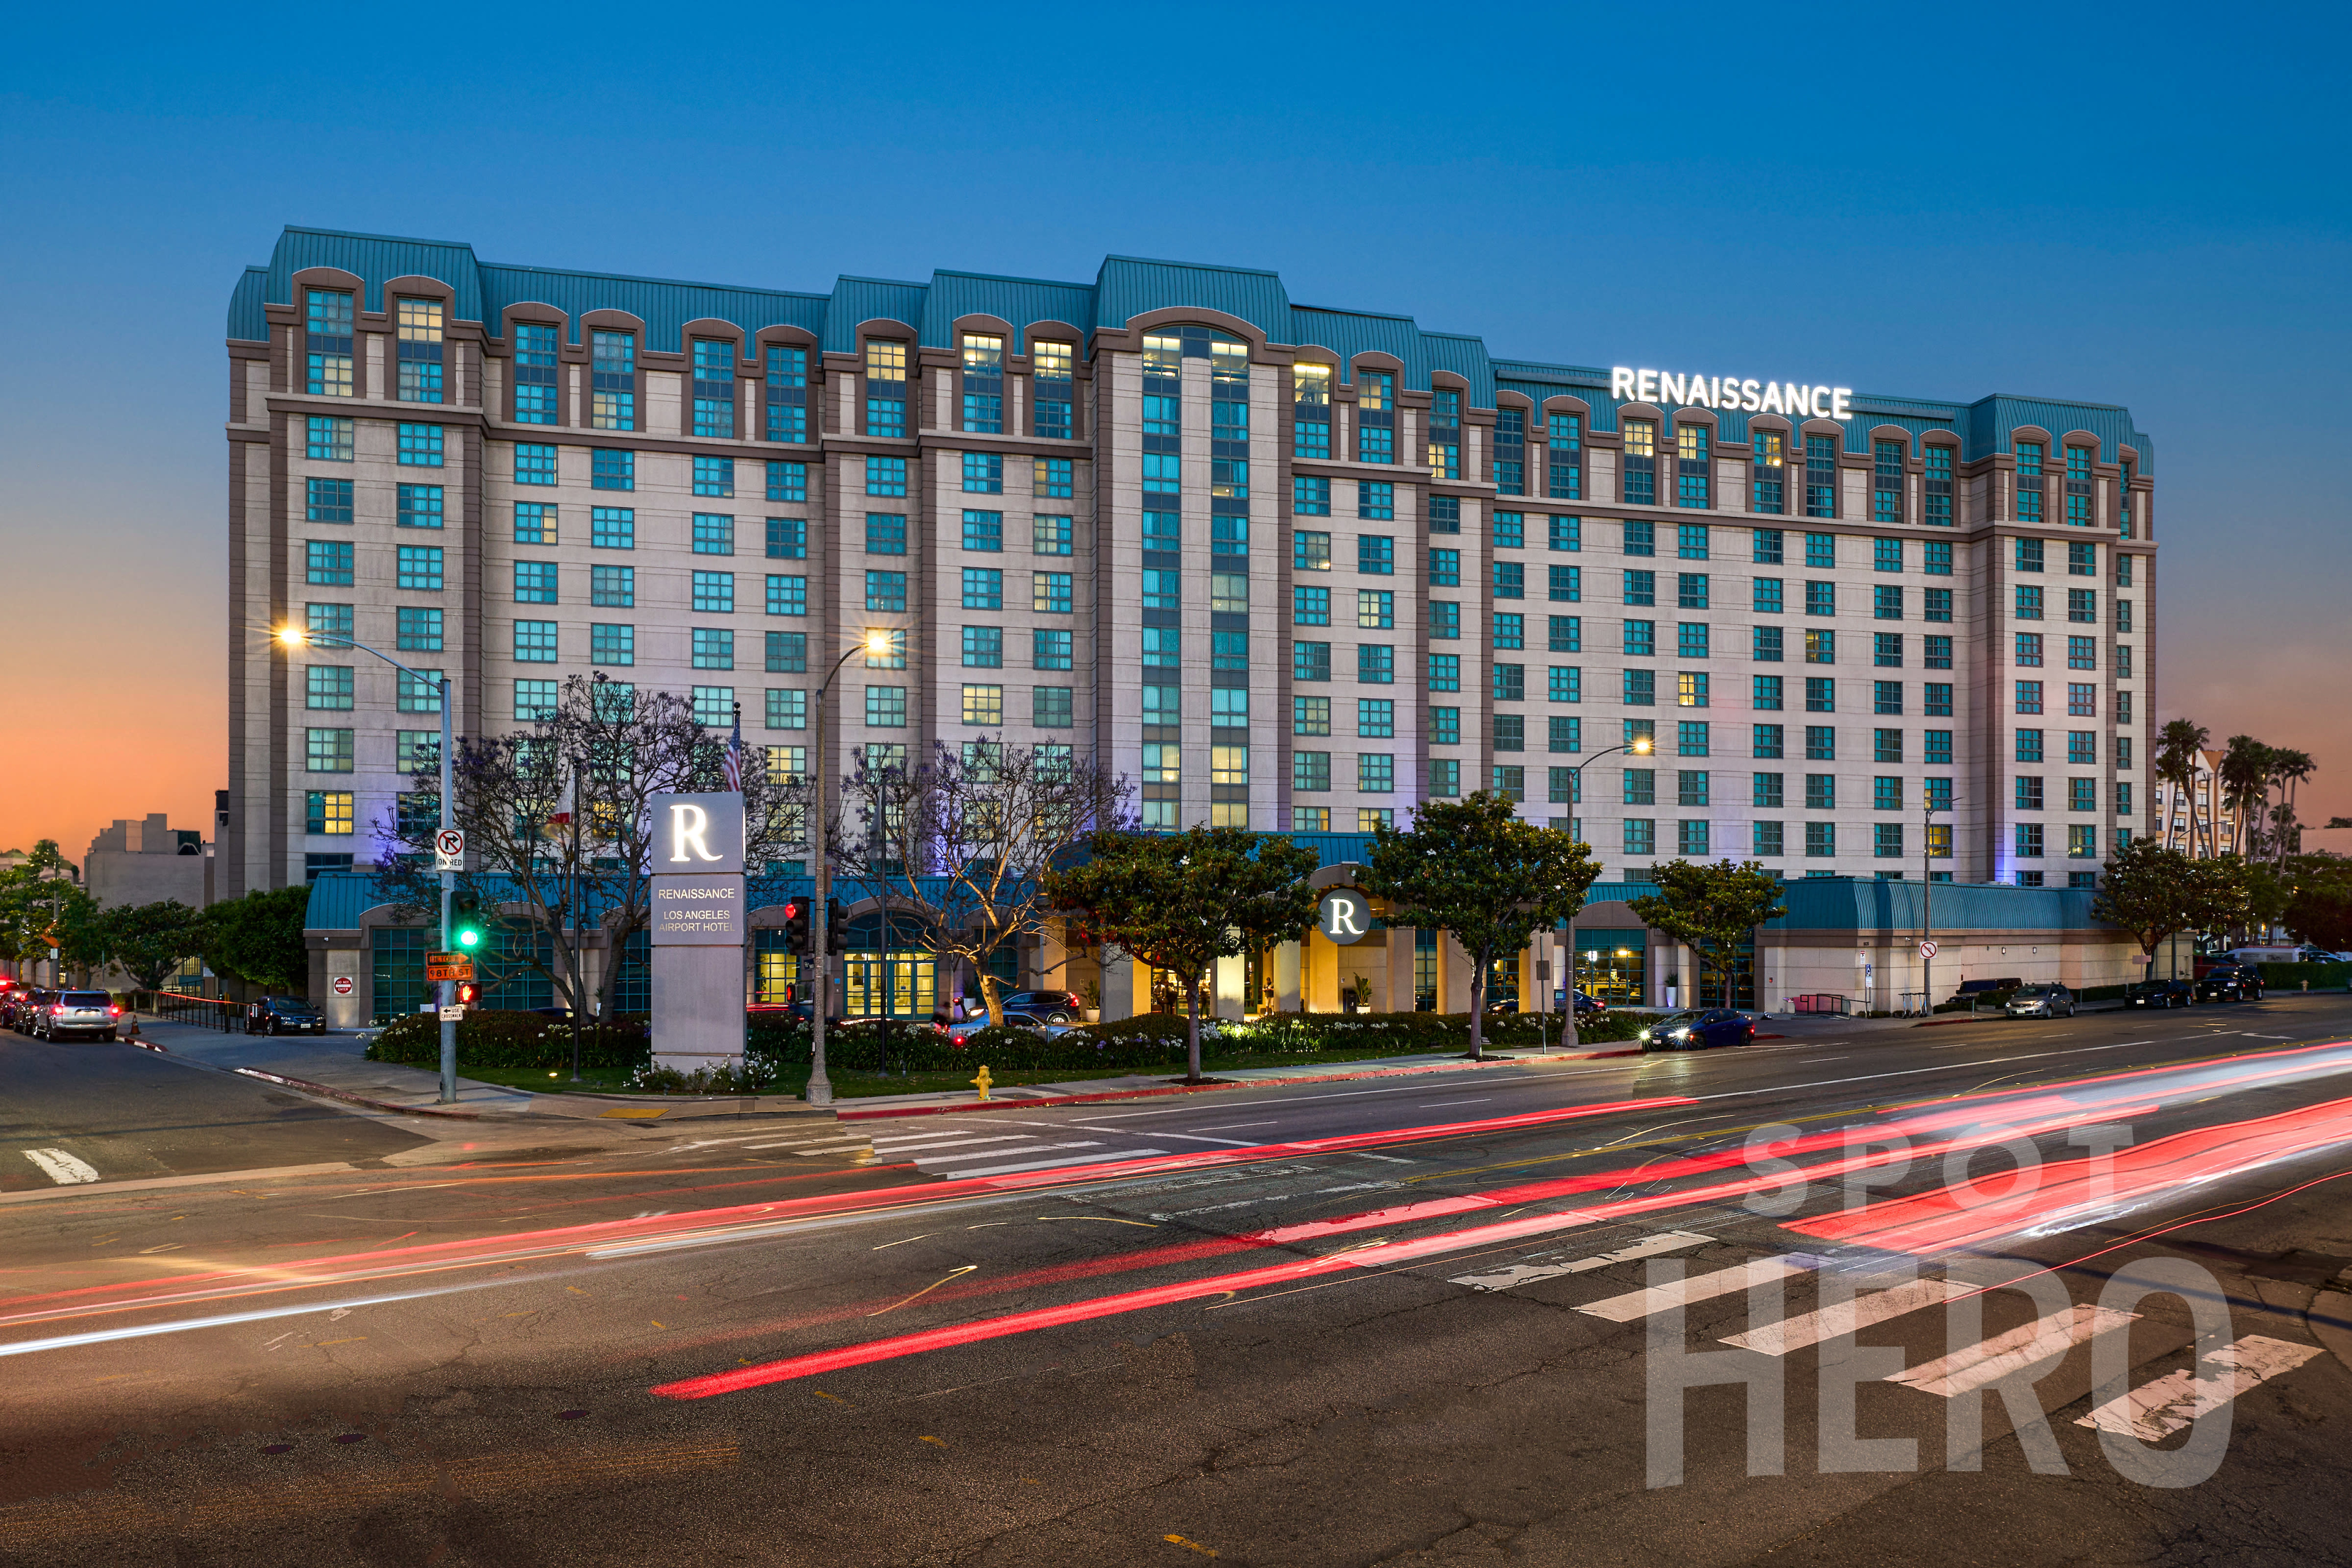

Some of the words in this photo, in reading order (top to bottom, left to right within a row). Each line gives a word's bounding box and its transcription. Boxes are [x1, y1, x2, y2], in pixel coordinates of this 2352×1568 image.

[1613, 366, 1852, 420] RENAISSANCE
[669, 804, 723, 862] R
[658, 888, 735, 899] RENAISSANCE
[663, 910, 683, 919] LOS
[685, 910, 730, 919] ANGELES
[1329, 899, 1365, 935] R
[659, 923, 701, 932] AIRPORT
[703, 922, 735, 932] HOTEL
[430, 969, 454, 978] 98TH
